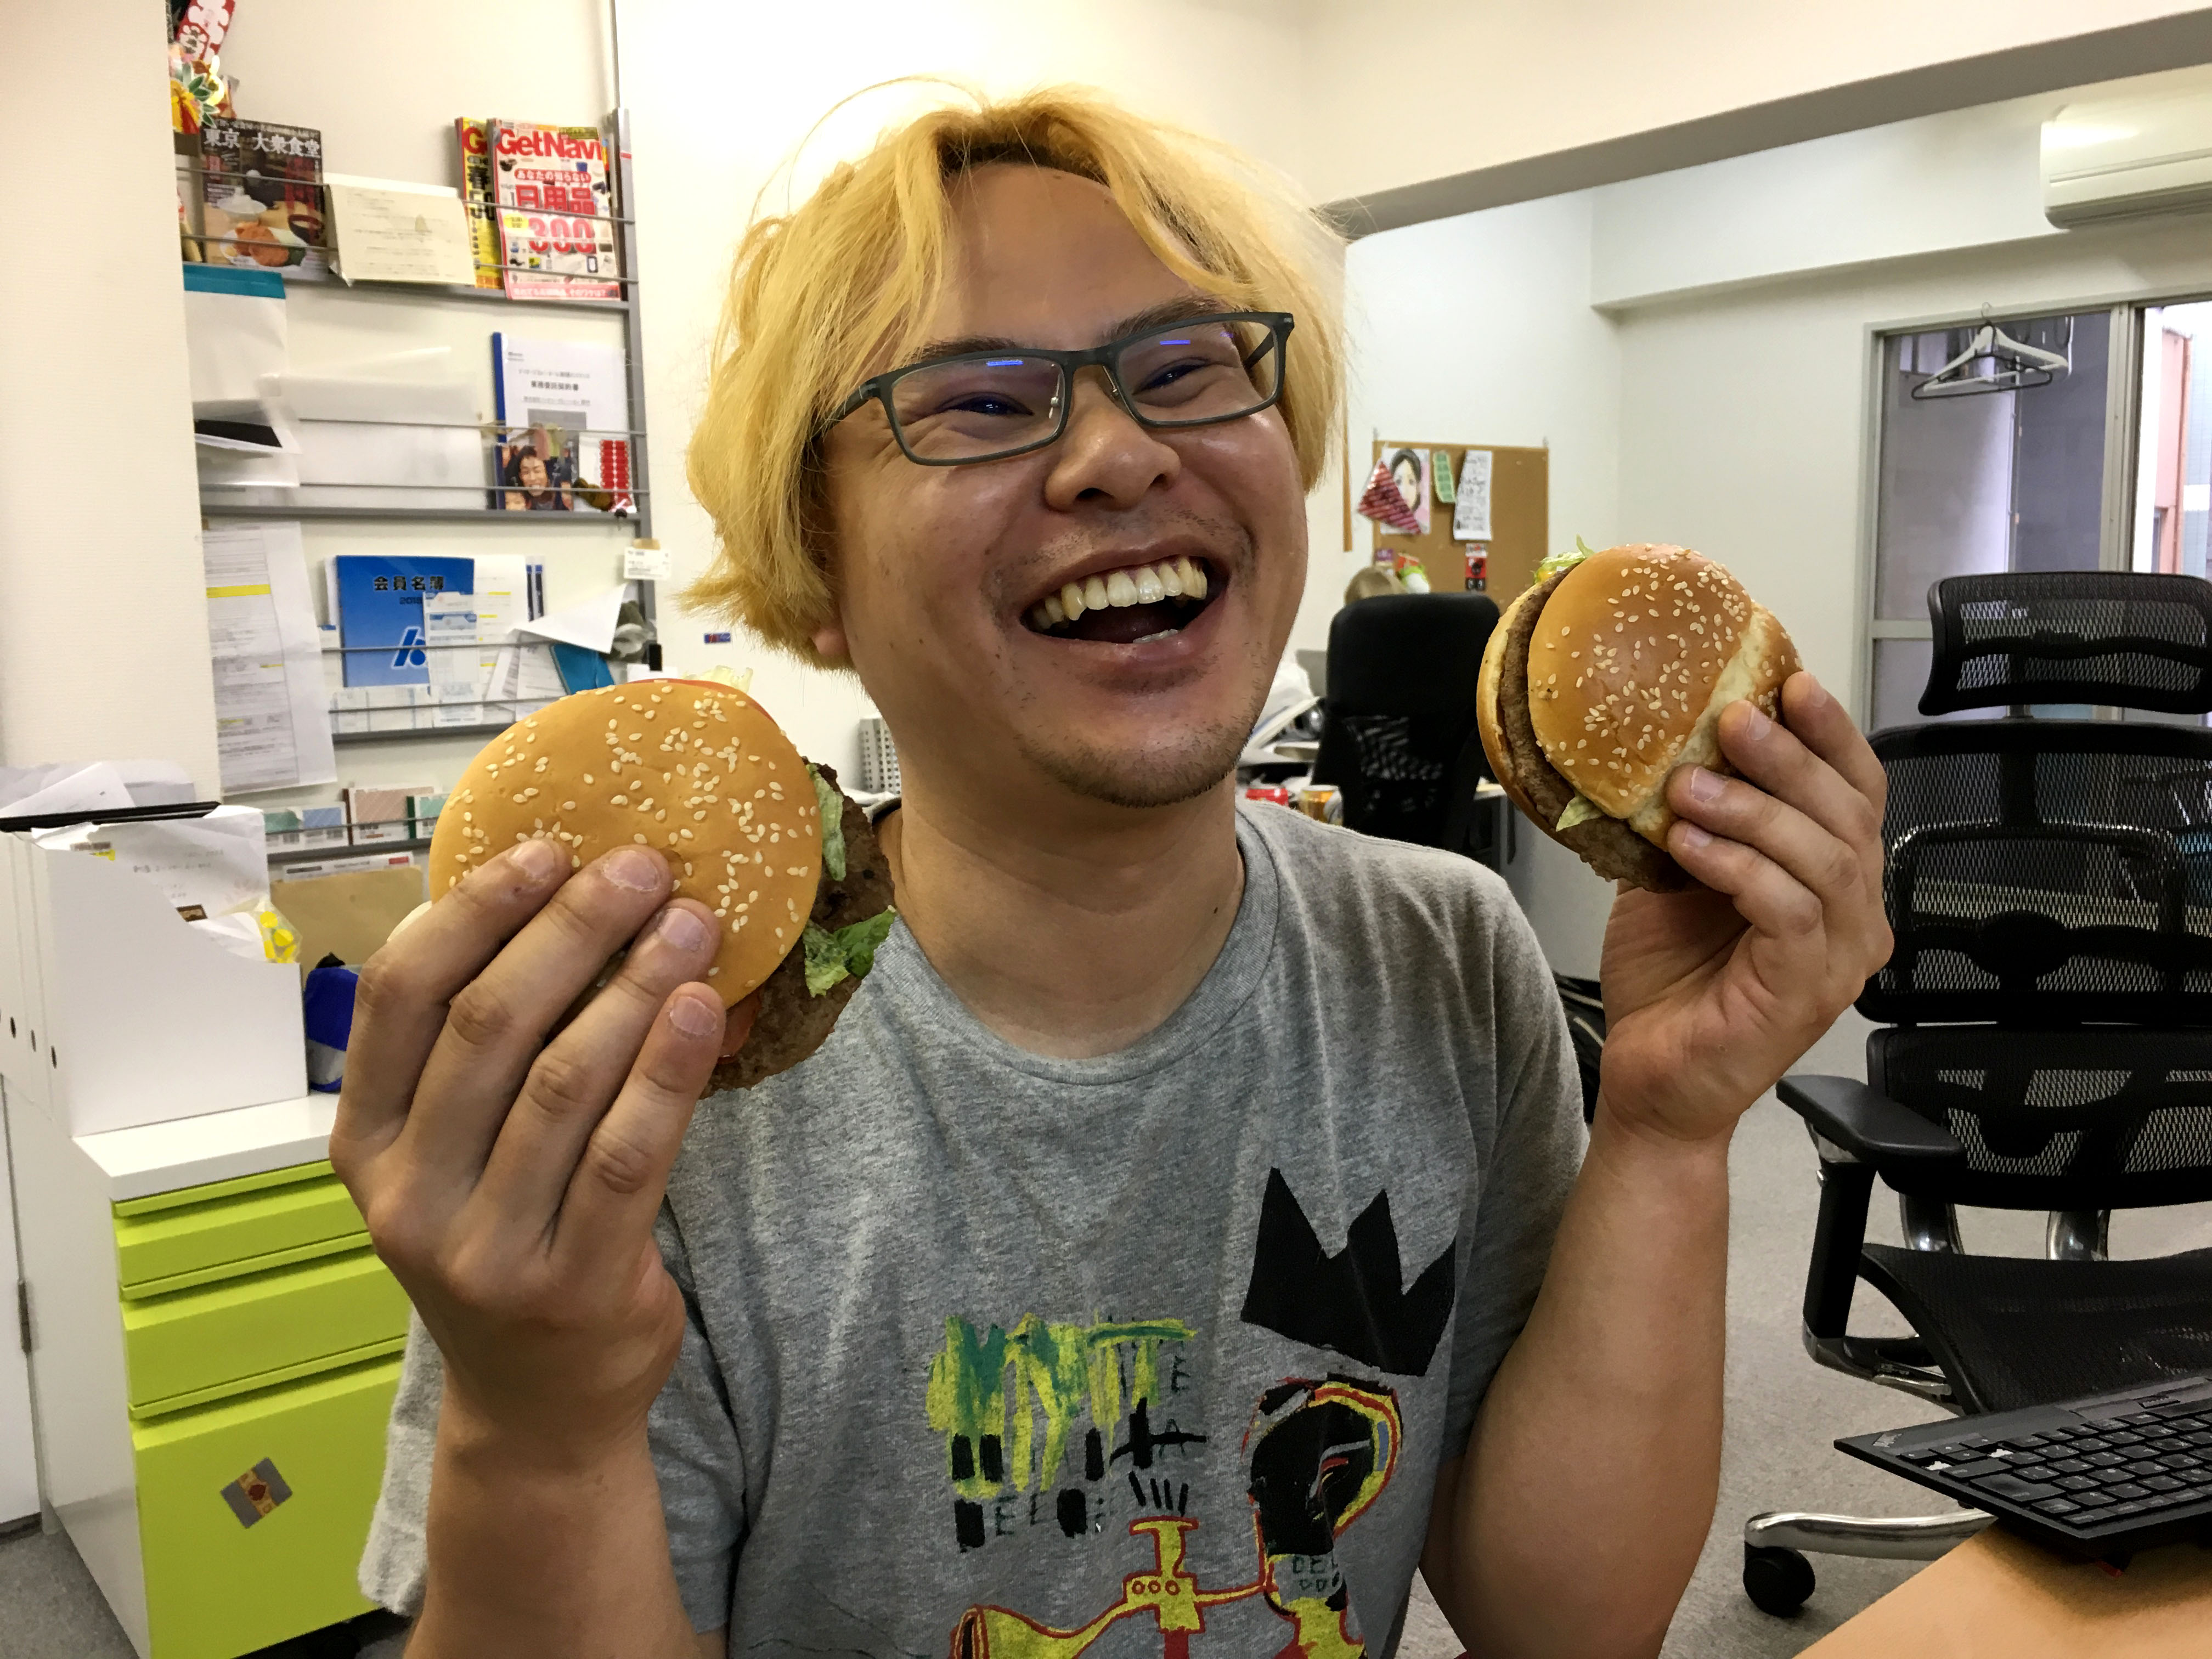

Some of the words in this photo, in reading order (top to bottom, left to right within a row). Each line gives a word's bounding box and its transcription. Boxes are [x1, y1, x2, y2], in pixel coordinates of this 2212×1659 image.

[204, 128, 241, 148] 東京
[252, 132, 321, 159] 大衆食堂
[495, 128, 602, 161] GetNavi
[517, 170, 590, 183] あなたの知らない
[516, 184, 596, 215] 日用品
[528, 217, 596, 254] 300
[374, 575, 444, 591] 会員名簿
